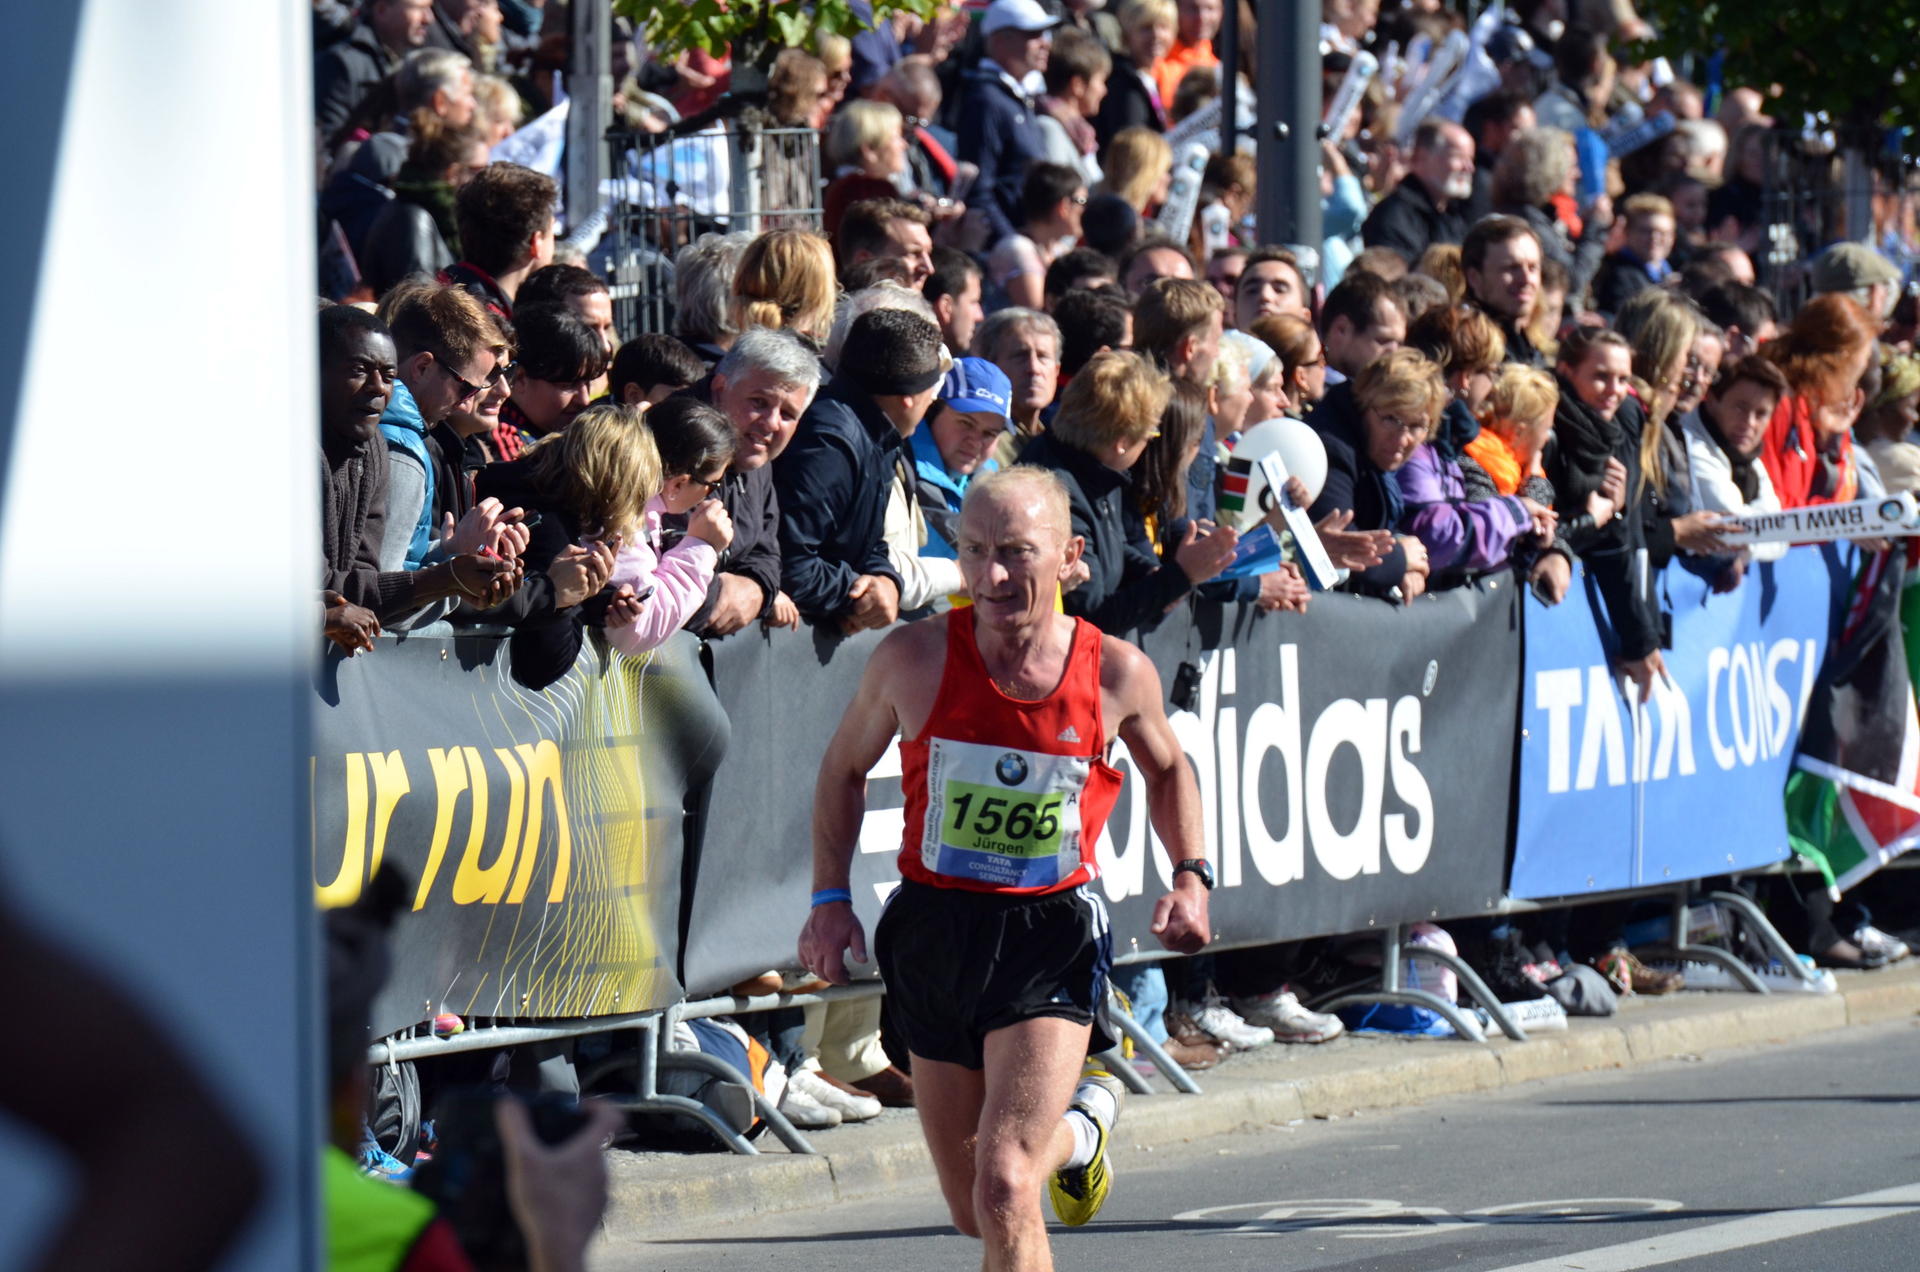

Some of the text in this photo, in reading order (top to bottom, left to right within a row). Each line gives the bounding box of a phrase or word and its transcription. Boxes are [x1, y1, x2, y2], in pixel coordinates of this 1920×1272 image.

[1807, 506, 1864, 531] BMW
[1095, 643, 1434, 903] adidas
[1067, 793, 1077, 805] A
[953, 792, 1062, 840] 1565
[412, 739, 571, 912] run
[972, 837, 1024, 855] Jürgen
[968, 861, 1028, 878] CONSULTANCY
[987, 855, 1012, 867] TATA
[978, 871, 1017, 886] SERVICES
